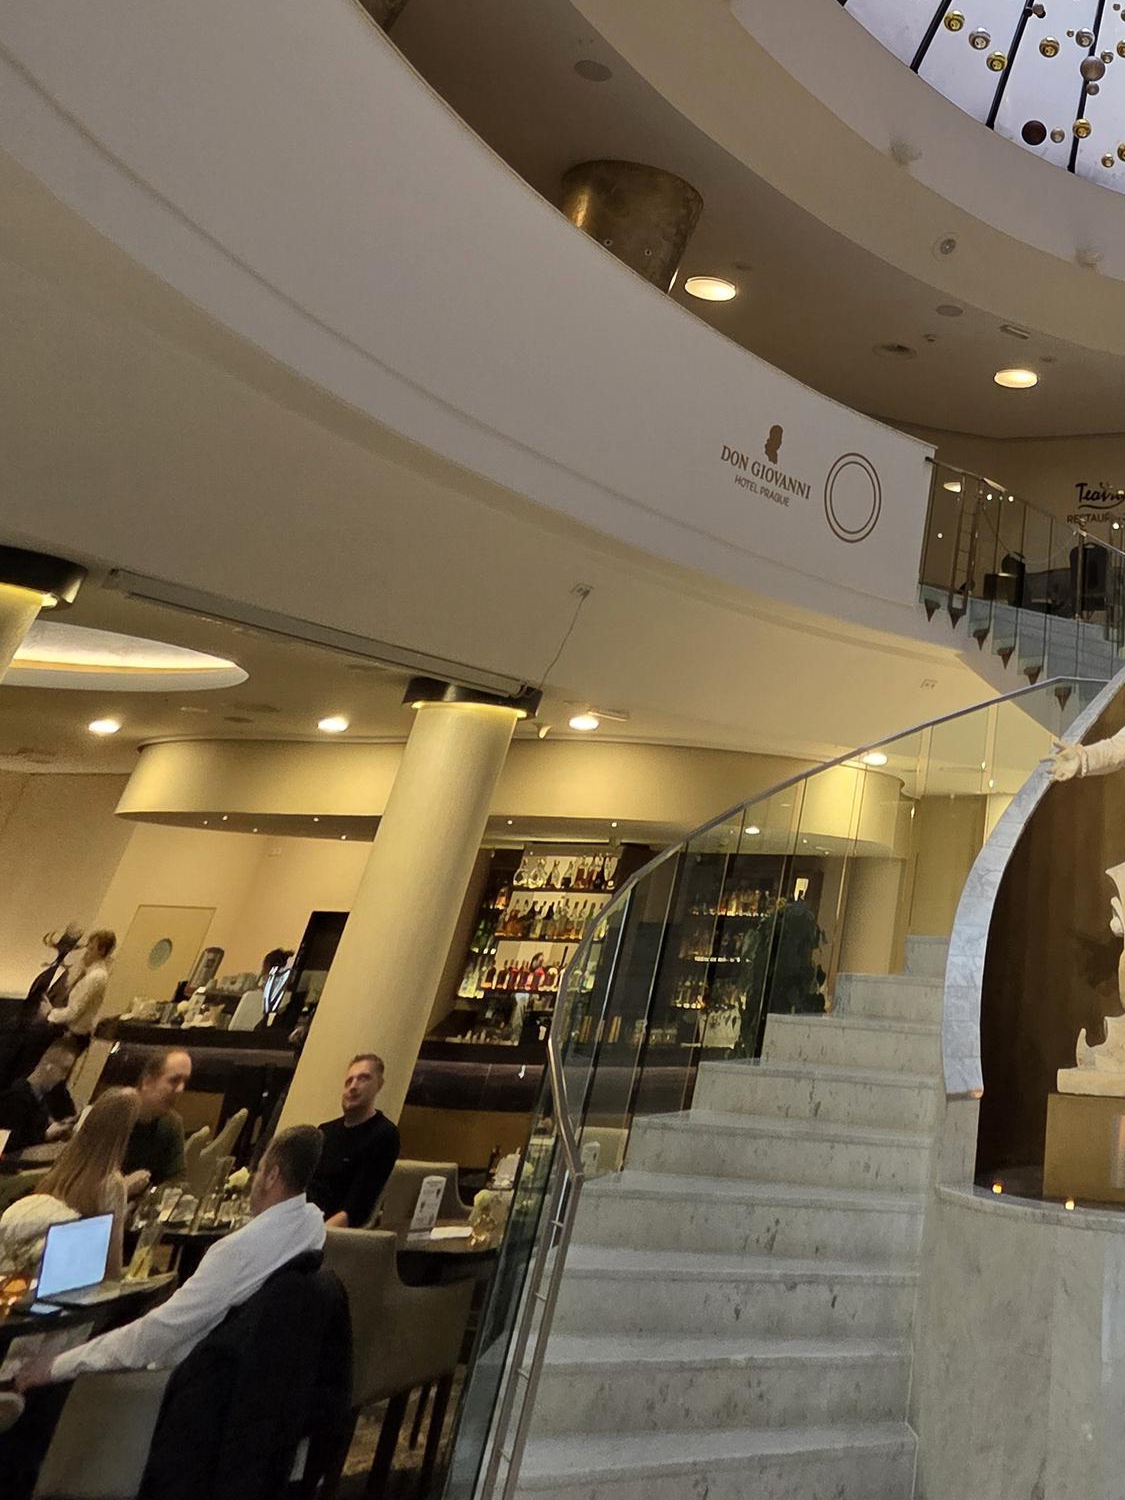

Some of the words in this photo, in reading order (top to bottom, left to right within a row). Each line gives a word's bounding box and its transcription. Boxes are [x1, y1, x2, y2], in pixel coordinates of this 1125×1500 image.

[720, 445, 750, 471] DON
[751, 460, 812, 500] GIOVANNI
[734, 474, 759, 494] HOTEL
[759, 486, 791, 508] PRAGUE
